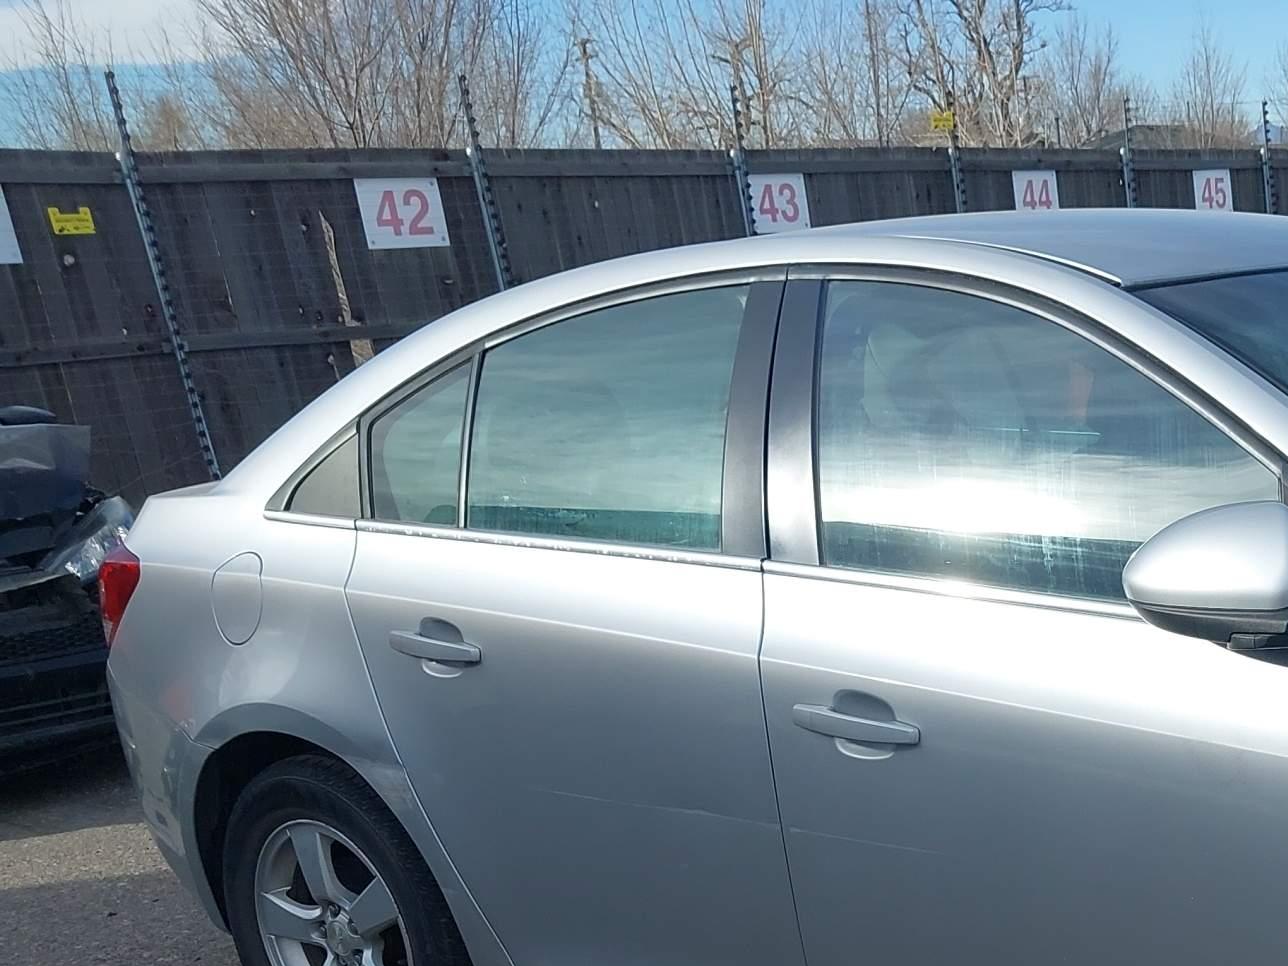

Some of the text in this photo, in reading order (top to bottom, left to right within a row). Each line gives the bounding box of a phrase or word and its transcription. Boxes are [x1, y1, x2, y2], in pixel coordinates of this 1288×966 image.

[759, 183, 799, 223] 43
[1023, 179, 1053, 210] 44
[1202, 177, 1226, 209] 45
[376, 190, 434, 236] 42
